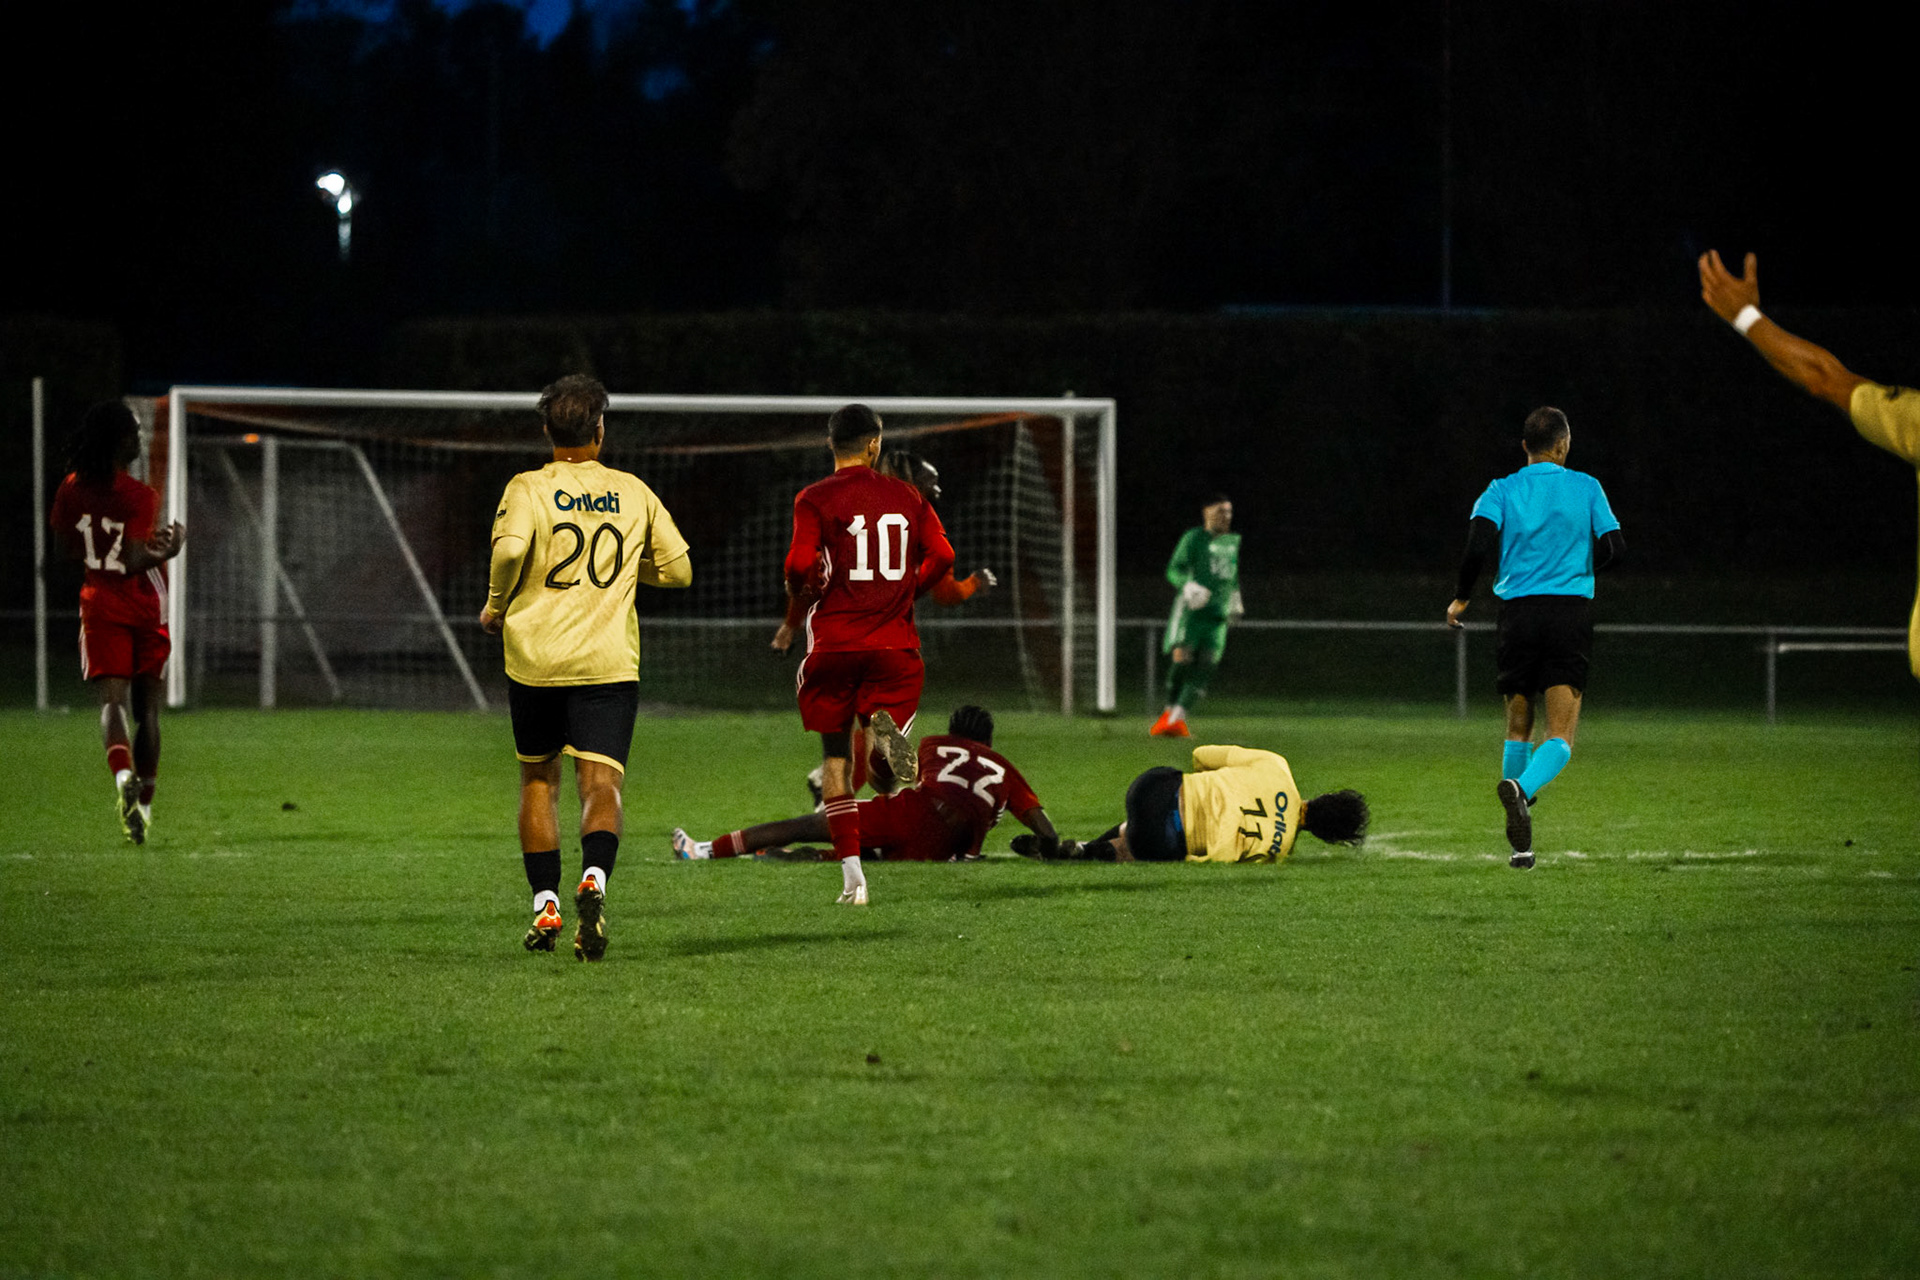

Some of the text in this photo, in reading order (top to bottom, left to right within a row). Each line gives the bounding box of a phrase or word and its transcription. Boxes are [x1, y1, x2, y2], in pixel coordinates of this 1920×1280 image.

[554, 489, 620, 514] Orllati
[75, 513, 127, 575] 12
[544, 522, 623, 590] 20
[846, 513, 909, 581] 10
[936, 746, 1006, 808] 22
